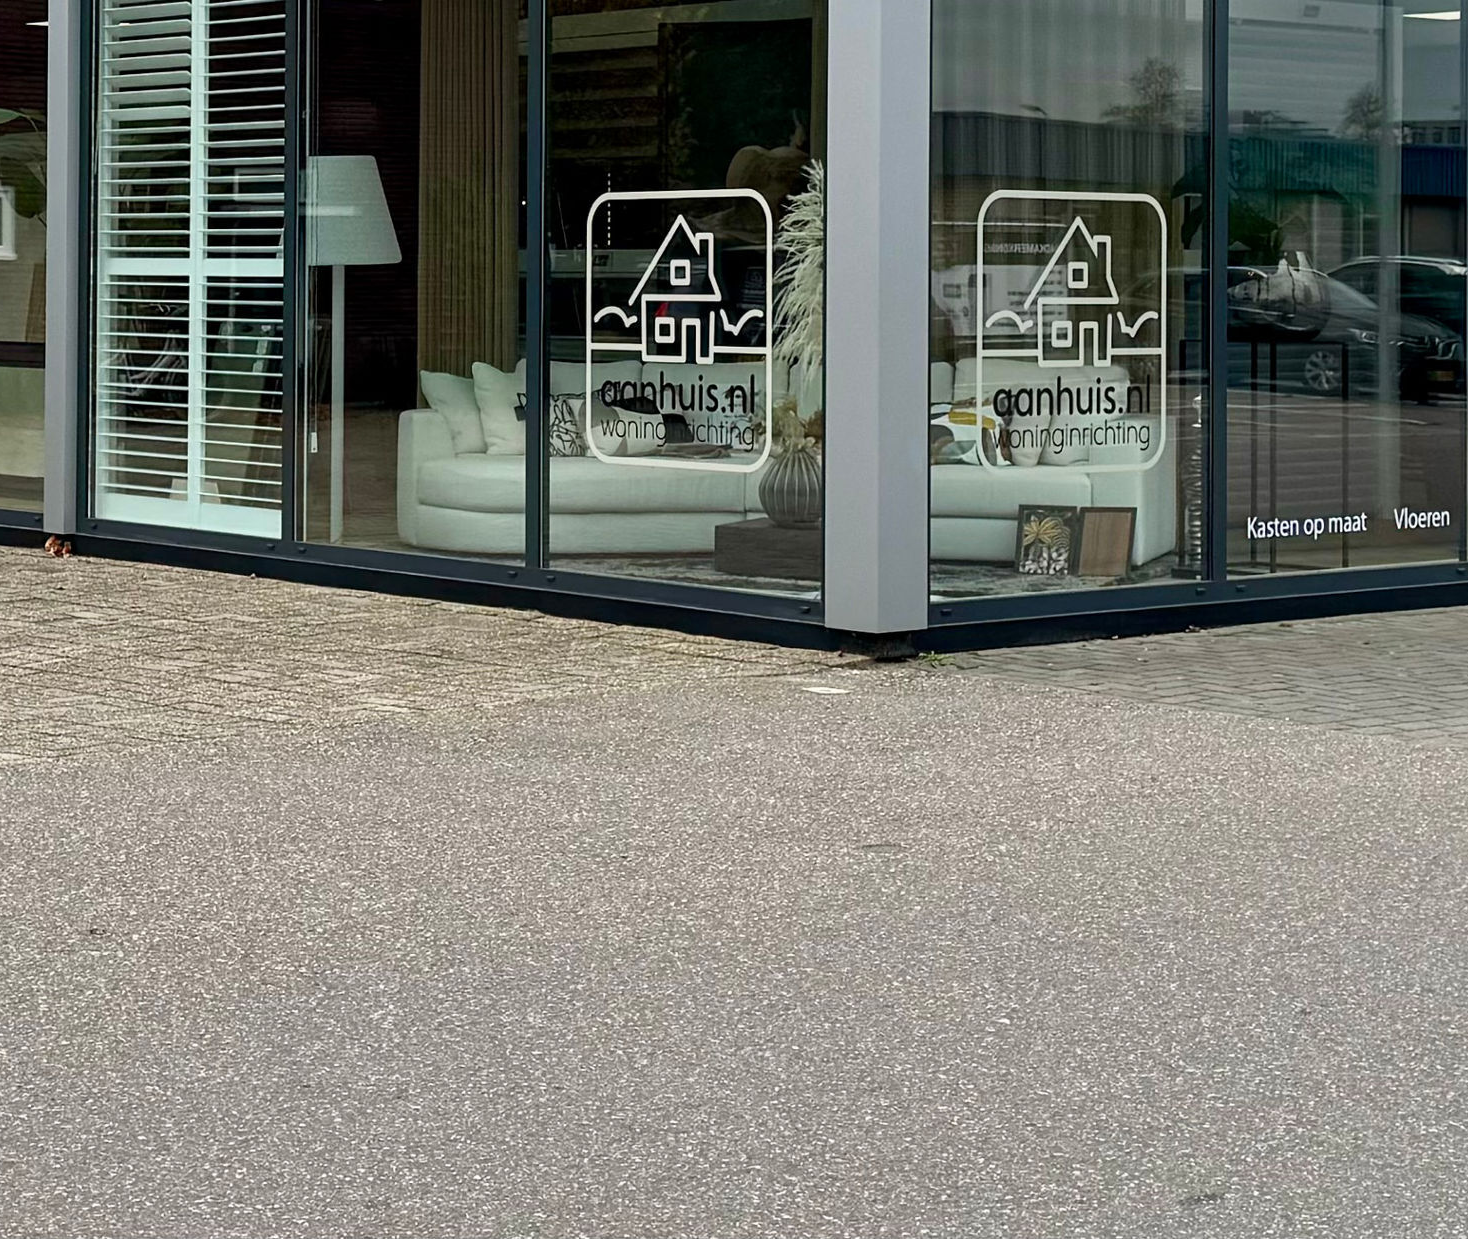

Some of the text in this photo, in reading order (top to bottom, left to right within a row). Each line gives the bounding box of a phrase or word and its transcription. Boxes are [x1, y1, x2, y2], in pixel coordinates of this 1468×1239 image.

[600, 370, 756, 414] aanhuis.nl
[992, 374, 1151, 417] aanhuis.nl
[993, 419, 1151, 454] woninginrichting
[1246, 507, 1451, 540] Kasten op maat Vloeren
